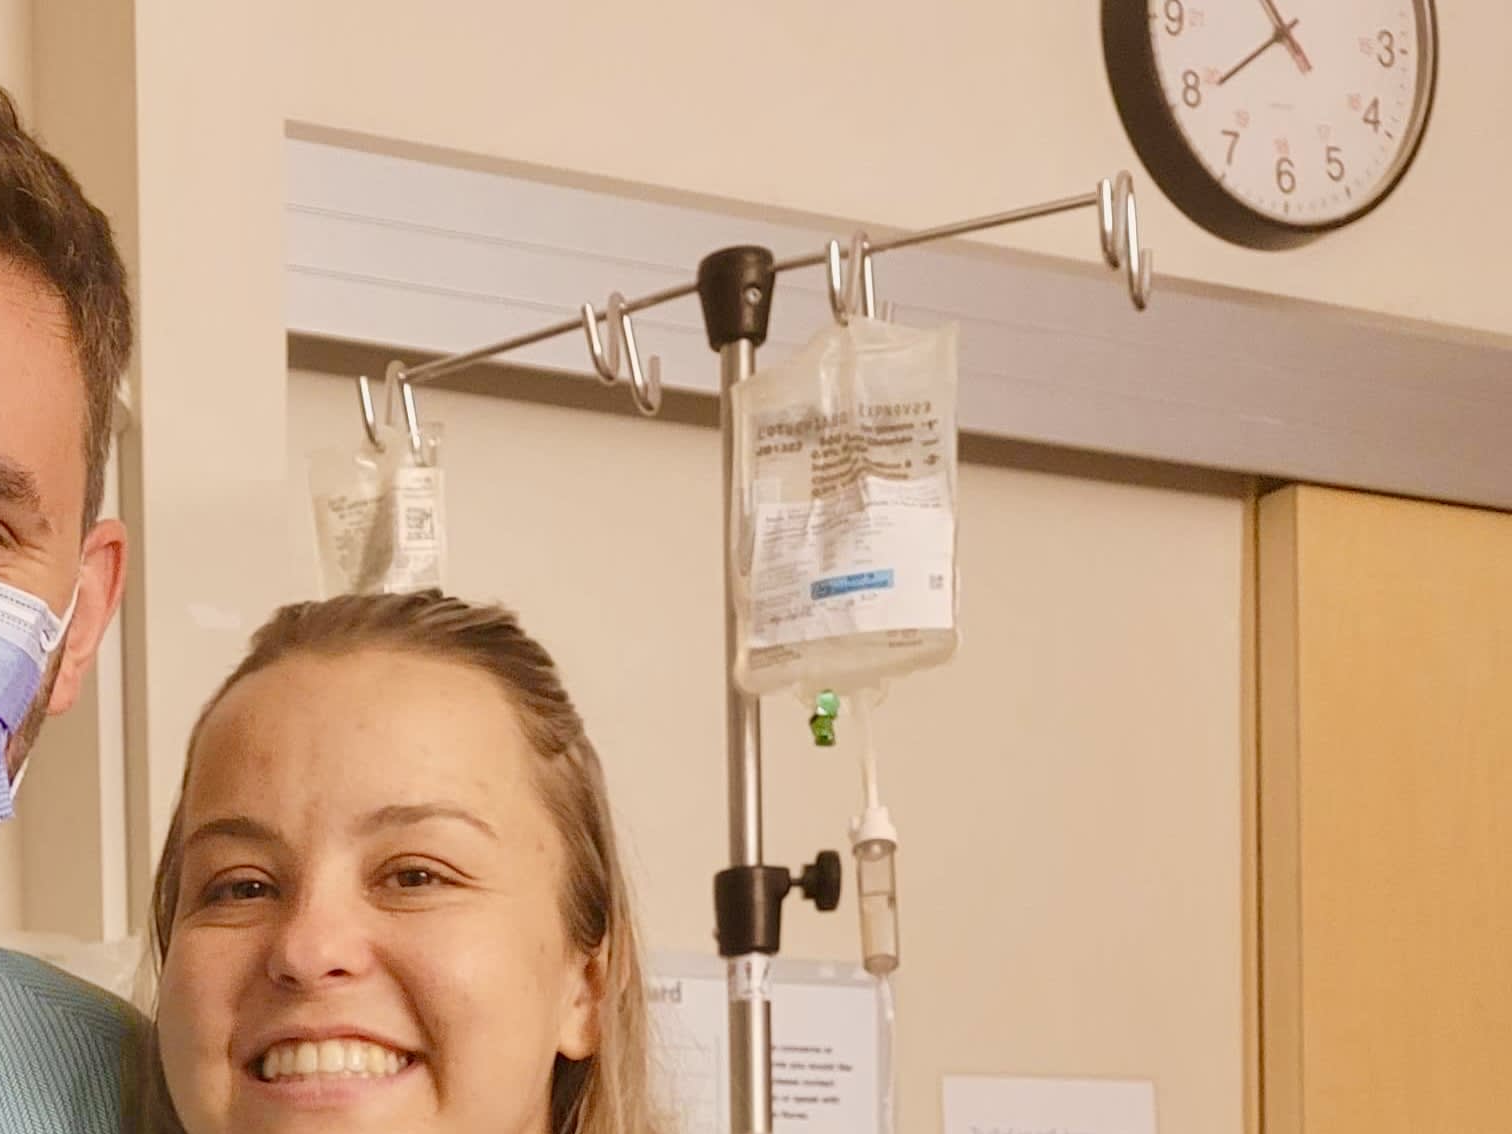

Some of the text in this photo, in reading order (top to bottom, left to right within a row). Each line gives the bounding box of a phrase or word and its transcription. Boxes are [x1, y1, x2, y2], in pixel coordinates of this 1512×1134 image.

[1163, 0, 1185, 37] 9
[1376, 29, 1396, 69] 3
[1181, 69, 1202, 108] 8
[1361, 97, 1381, 134] 4
[1220, 129, 1241, 166] 7
[1324, 145, 1346, 183] 5
[1275, 157, 1297, 195] 6
